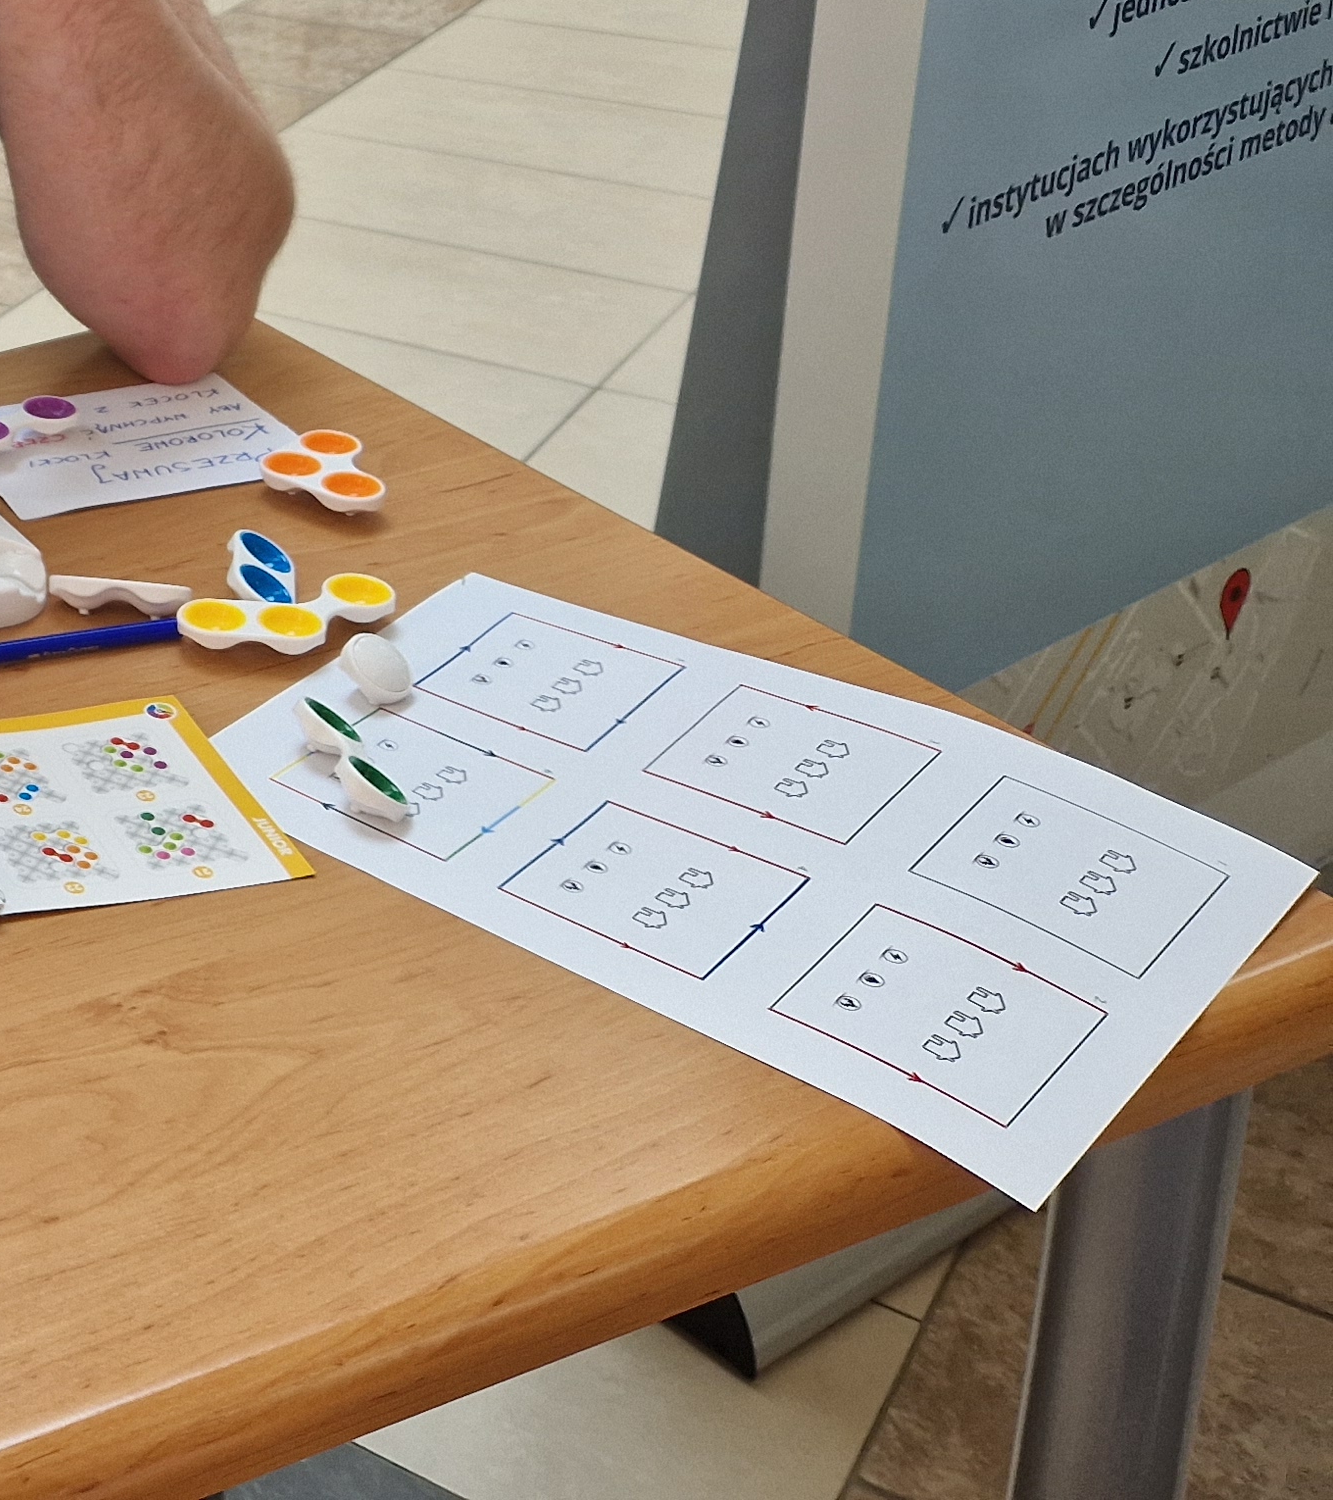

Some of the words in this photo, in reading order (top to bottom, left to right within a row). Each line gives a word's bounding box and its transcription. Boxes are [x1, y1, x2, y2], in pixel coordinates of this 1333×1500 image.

[967, 139, 1121, 229] instytucjach
[1128, 59, 1333, 164] wykorzystujących
[1045, 210, 1067, 238] w
[1072, 135, 1234, 229] szczególności
[1239, 102, 1326, 160] metody
[130, 388, 220, 408] KLOCEK
[209, 403, 241, 415] ABY
[136, 422, 269, 452] KOLOROWE
[29, 451, 110, 468] KLOCKI
[252, 816, 293, 857] JUNIOR
